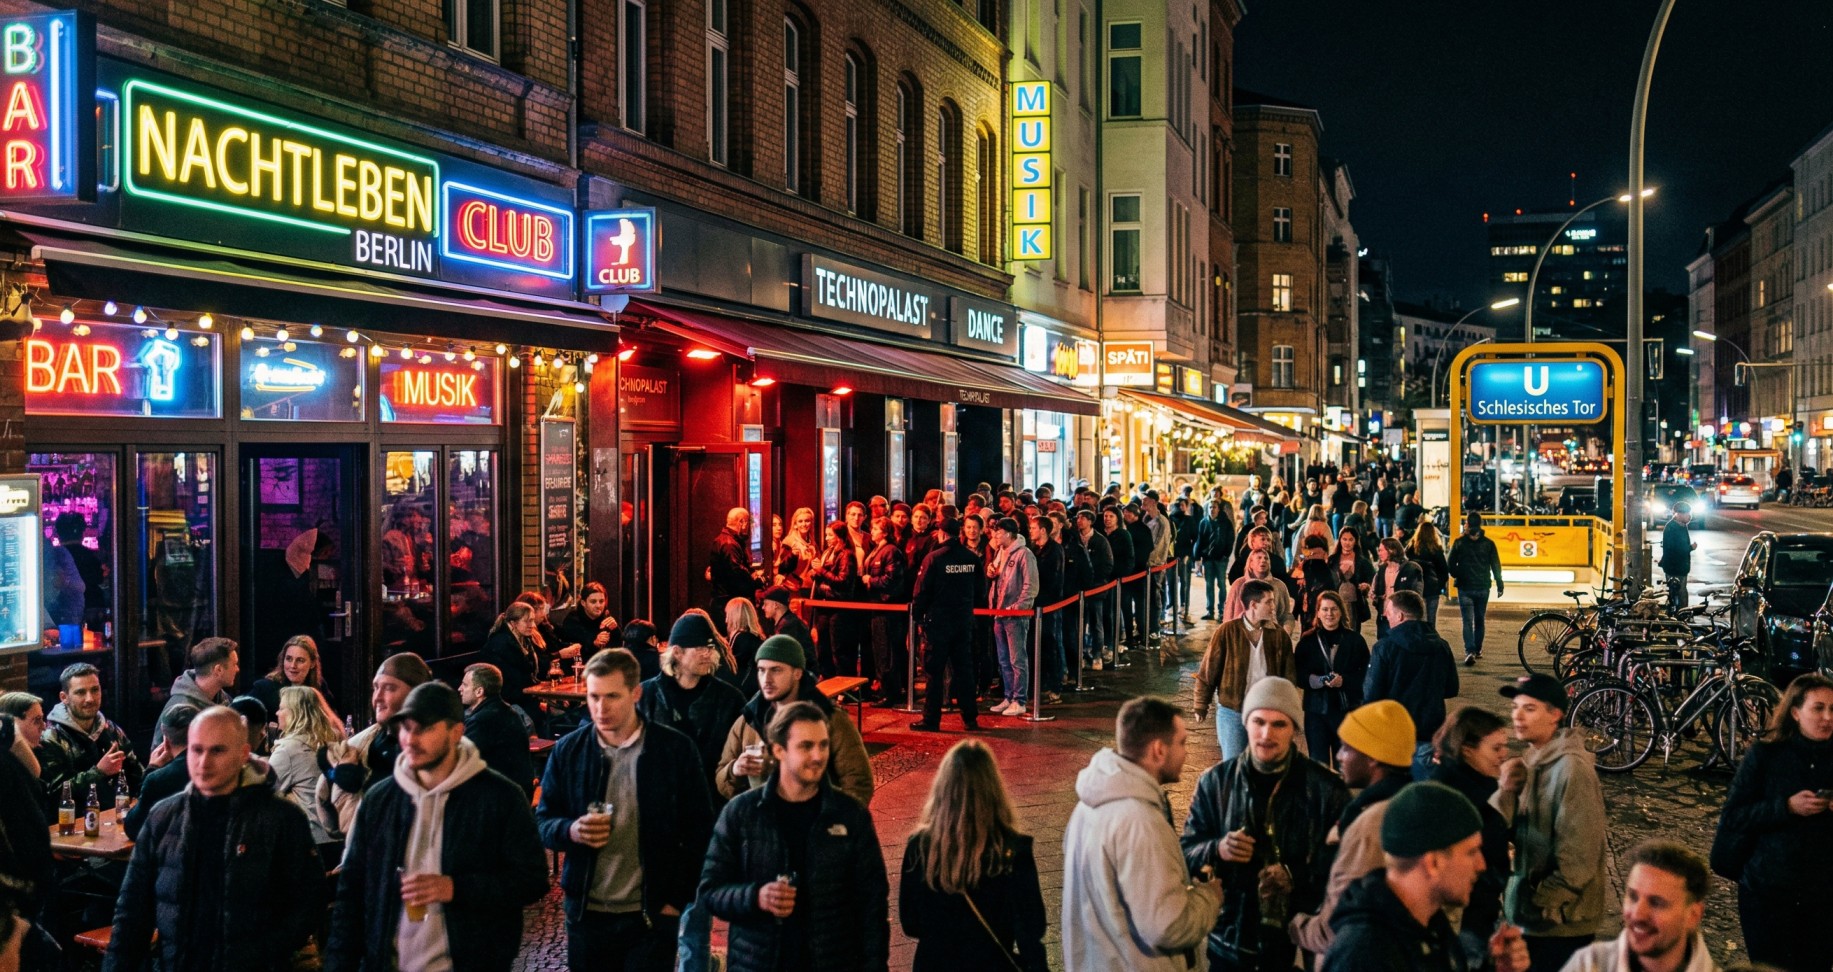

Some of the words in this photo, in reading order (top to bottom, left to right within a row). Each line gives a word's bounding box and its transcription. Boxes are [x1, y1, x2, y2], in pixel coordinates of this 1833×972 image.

[3, 22, 40, 190] BAR
[139, 105, 433, 232] NACHTLEBEN
[1017, 85, 1046, 254] MUSIK
[461, 200, 554, 263] CLUB
[355, 229, 432, 273] BERLIN
[598, 267, 641, 285] CLUB
[815, 266, 929, 327] TECHNOPALAST
[967, 308, 1004, 345] DANCE
[27, 339, 122, 394] BAR
[1107, 348, 1149, 366] SPÄTI
[404, 370, 477, 407] MUSIK
[620, 377, 668, 394] CHNOPALAST
[1523, 366, 1549, 396] U
[1478, 398, 1569, 415] Schlesisches
[1572, 400, 1596, 415] Tor
[945, 564, 975, 573] SECURITY
